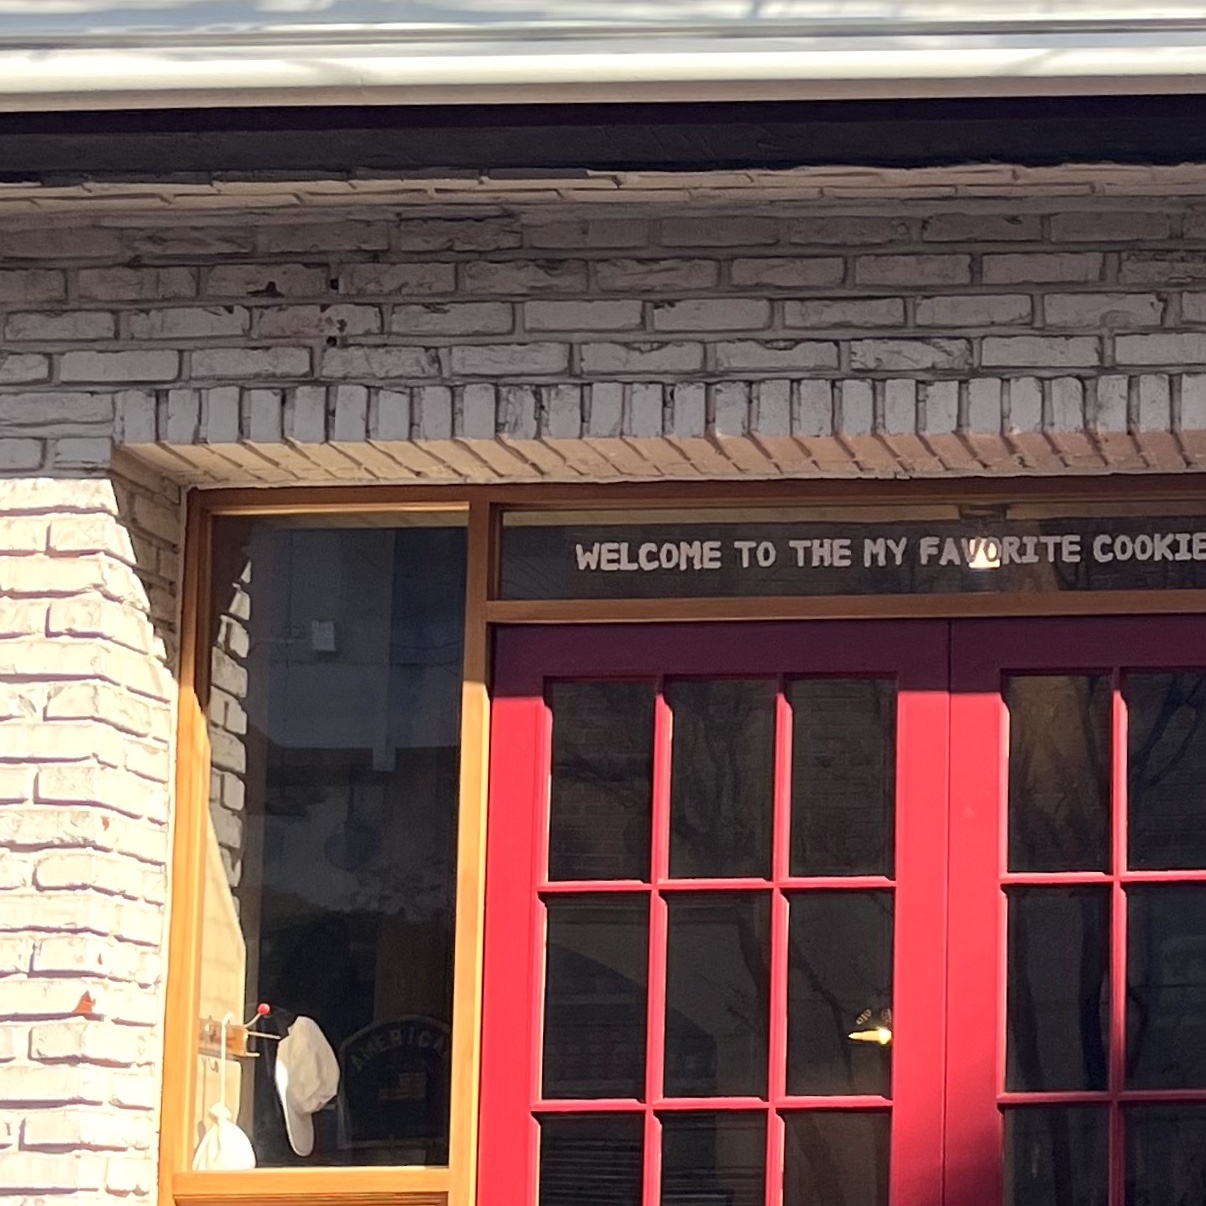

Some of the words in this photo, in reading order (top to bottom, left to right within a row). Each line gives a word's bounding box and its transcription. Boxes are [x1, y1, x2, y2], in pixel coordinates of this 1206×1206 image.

[575, 540, 722, 571] WELCOME
[734, 540, 777, 568] TO
[789, 538, 851, 568] THE
[863, 537, 908, 567] MY
[919, 534, 1082, 566] FAVORITE
